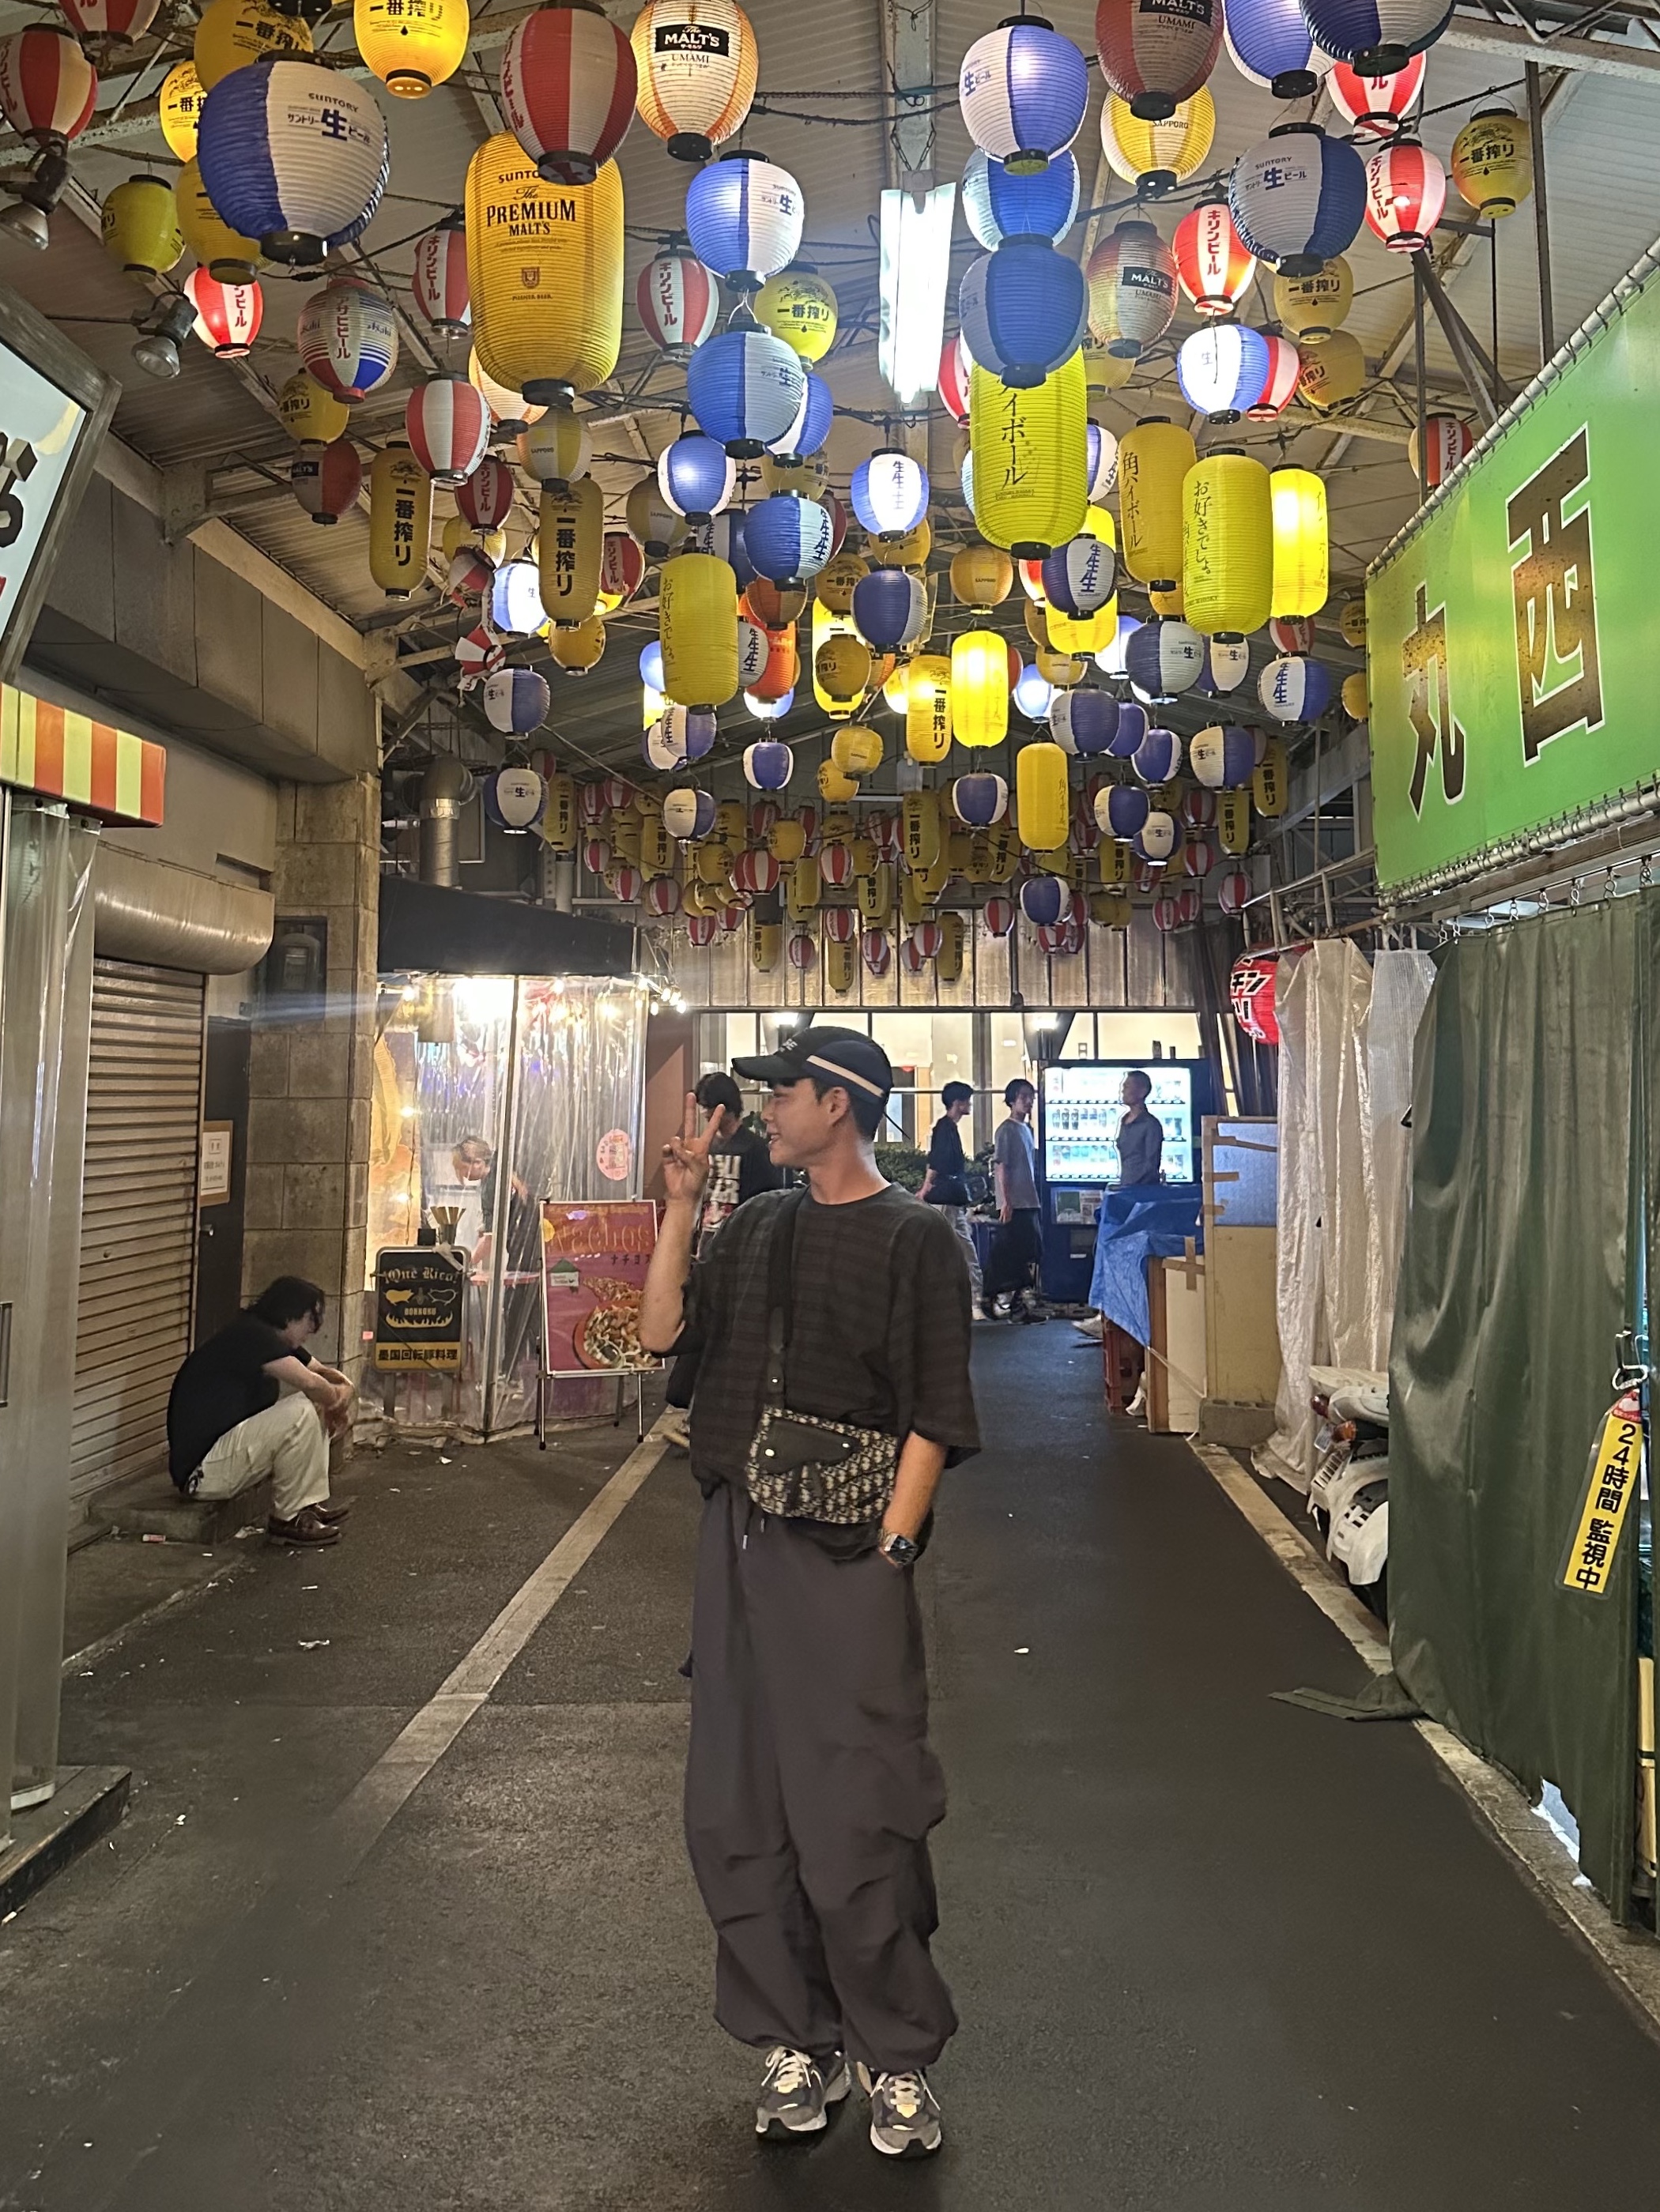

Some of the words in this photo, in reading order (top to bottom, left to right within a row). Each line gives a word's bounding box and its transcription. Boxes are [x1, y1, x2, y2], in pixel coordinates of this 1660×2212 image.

[664, 32, 720, 47] MALT'S
[1157, 14, 1197, 30] UMAMI
[671, 52, 710, 63] UMAMI
[307, 92, 360, 113] SUNTORY
[1254, 155, 1292, 169] SUNTORY
[1460, 143, 1515, 164] 一番搾り
[498, 170, 541, 184] SUNTO
[512, 184, 540, 201] The
[1369, 154, 1390, 222] キリンビール
[486, 199, 576, 228] PREMIUM
[509, 220, 551, 237] MALT'S
[1206, 209, 1223, 277] キリンビール
[658, 262, 678, 327] キリンビール
[1130, 273, 1169, 289] MALT'S
[1288, 277, 1342, 294] 一番搾り
[336, 296, 351, 359] アサヒビール
[778, 303, 829, 320] 一番搾り
[999, 386, 1028, 490] イボール
[1445, 421, 1462, 471] キリンビール
[1122, 451, 1143, 547] 角ハイボール
[394, 487, 416, 567] 一番搾り
[556, 517, 576, 597] 一番搾り
[934, 689, 947, 749] 一番搾り
[559, 793, 569, 835] 一番搾り
[909, 814, 921, 859] 一番搾り
[995, 833, 1010, 876] 一番搾り
[1575, 1517, 1615, 1590] 監視中
